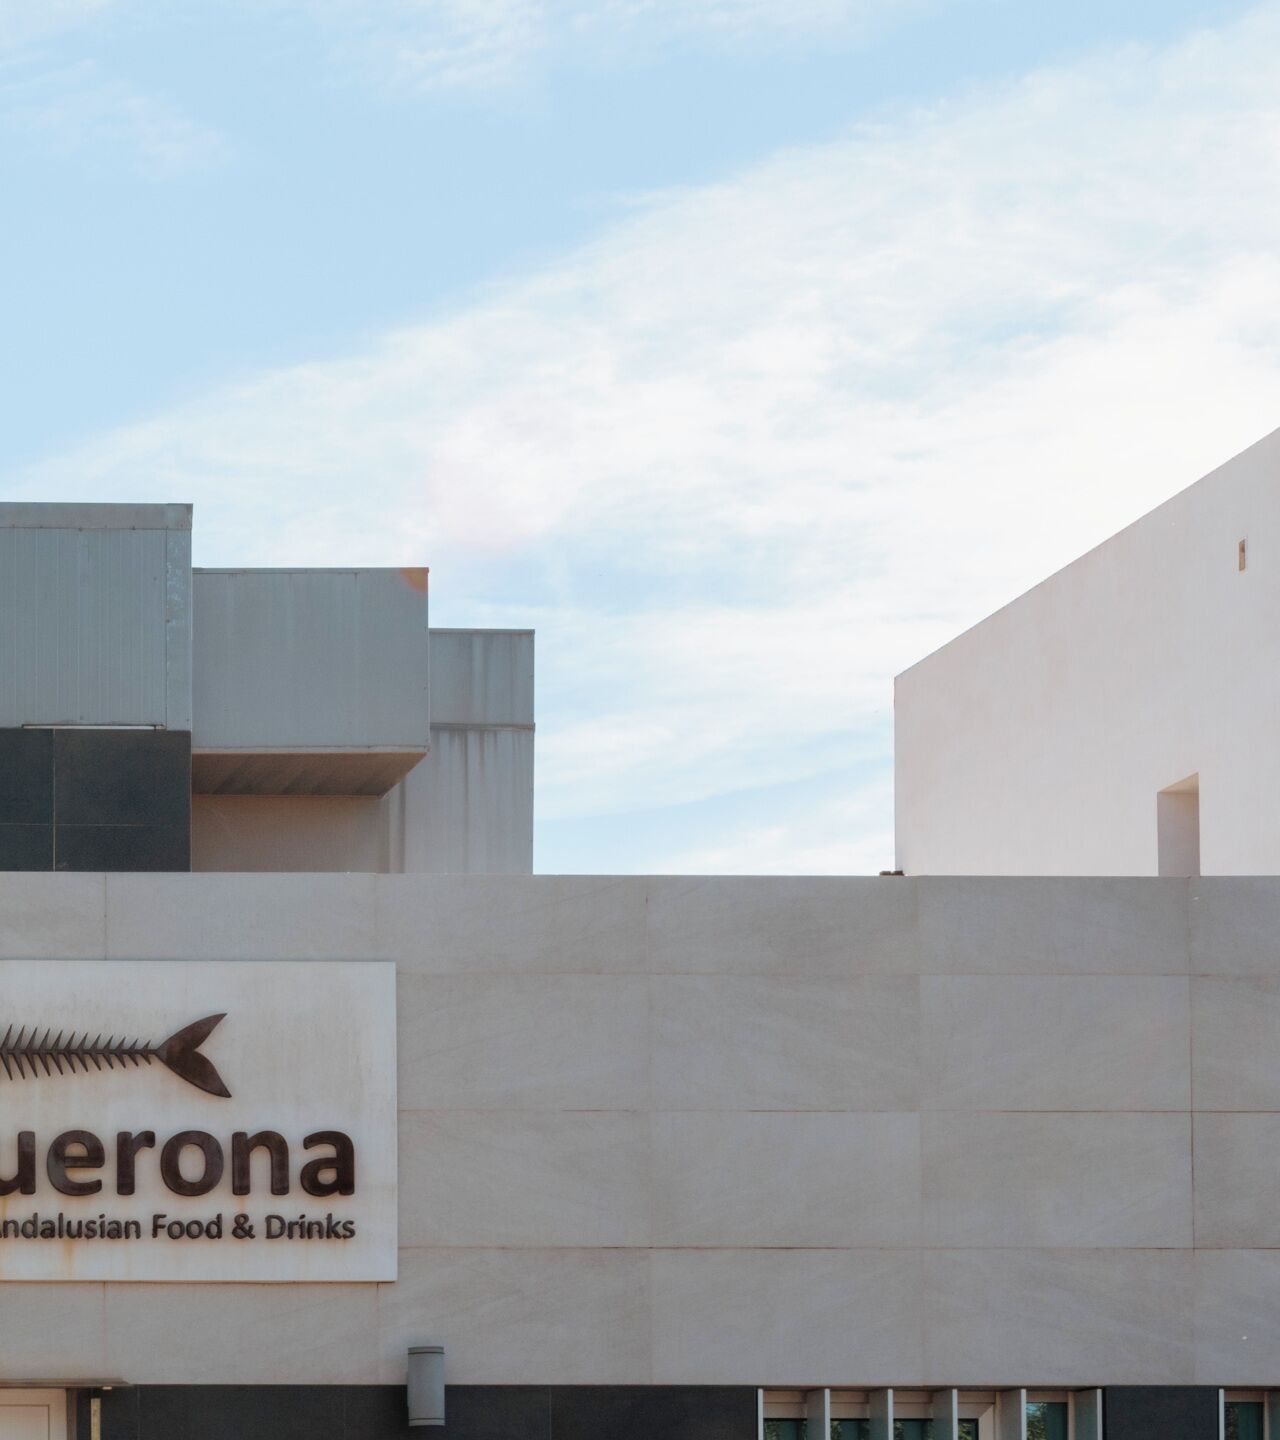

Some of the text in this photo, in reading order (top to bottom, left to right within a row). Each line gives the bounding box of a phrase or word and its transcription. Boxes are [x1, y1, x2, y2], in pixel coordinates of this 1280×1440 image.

[151, 1213, 224, 1240] Food
[231, 1213, 256, 1240] &
[264, 1213, 357, 1240] Drinks
